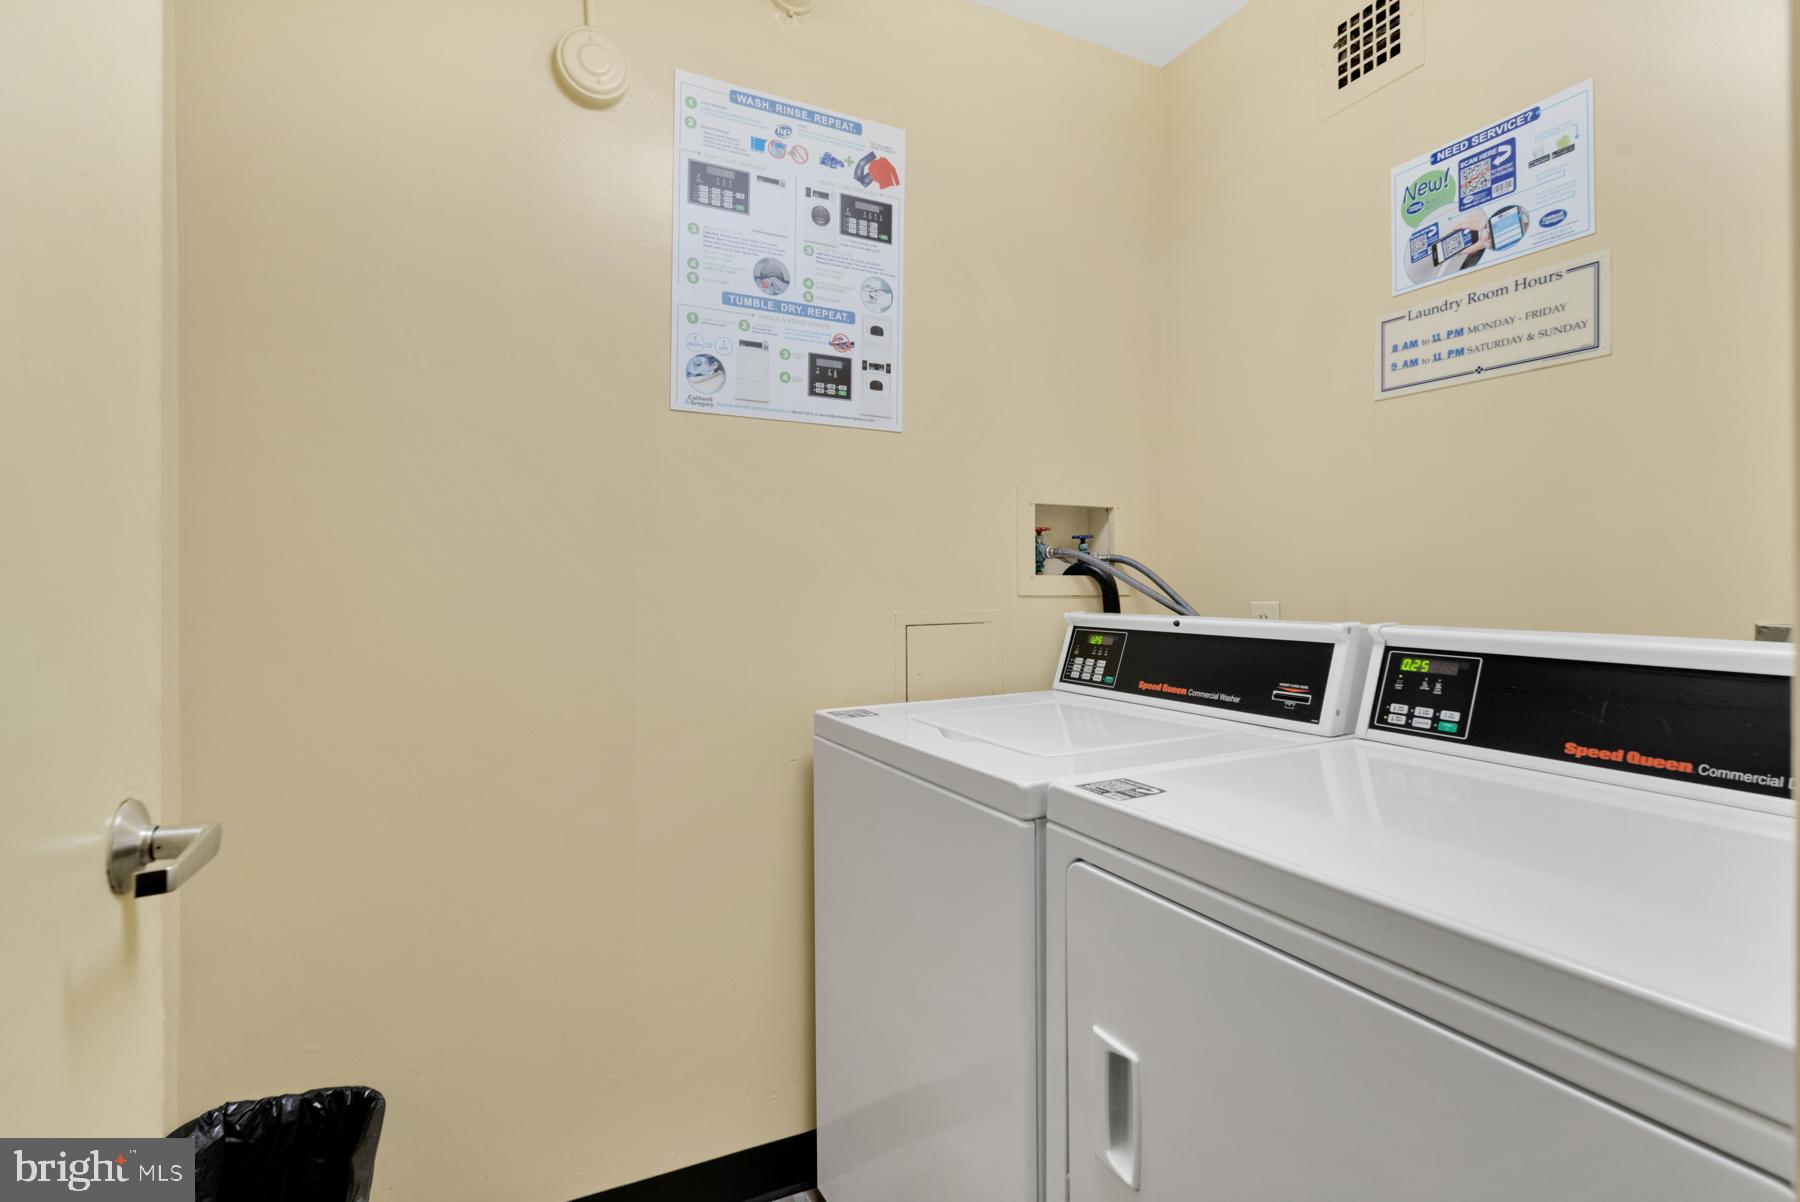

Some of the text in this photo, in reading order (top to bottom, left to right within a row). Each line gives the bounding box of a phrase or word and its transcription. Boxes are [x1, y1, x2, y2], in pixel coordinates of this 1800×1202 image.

[736, 93, 773, 111] WASH.
[776, 103, 811, 120] RINSE.
[814, 114, 857, 132] REPEAT.
[1437, 141, 1469, 161] NEED
[1471, 111, 1534, 146] SERVICE?
[1460, 156, 1479, 169] SCAN
[1403, 167, 1450, 204] New!
[728, 295, 850, 322] TUMBLE. DRY. REPEAT.
[1407, 270, 1563, 321] Laundry Room Hours
[1391, 343, 1399, 353] 8
[1402, 339, 1419, 351] AM
[1446, 327, 1465, 340] PM
[1467, 316, 1516, 335] MONDAY
[1525, 302, 1567, 321] FRIDAY
[1391, 362, 1398, 372] 9
[1402, 357, 1419, 369] AM
[1447, 347, 1466, 360] PM
[1467, 335, 1524, 355] SATURDAY
[1526, 332, 1535, 341] &
[1537, 320, 1589, 339] SUNDAY
[690, 400, 714, 408] Gregory
[1401, 658, 1430, 673] 0.25
[1138, 680, 1241, 704] Speed Queen Commercial Washer
[1564, 742, 1625, 762] Speed
[1626, 751, 1693, 774] Queen
[1698, 763, 1785, 789] Commercial
